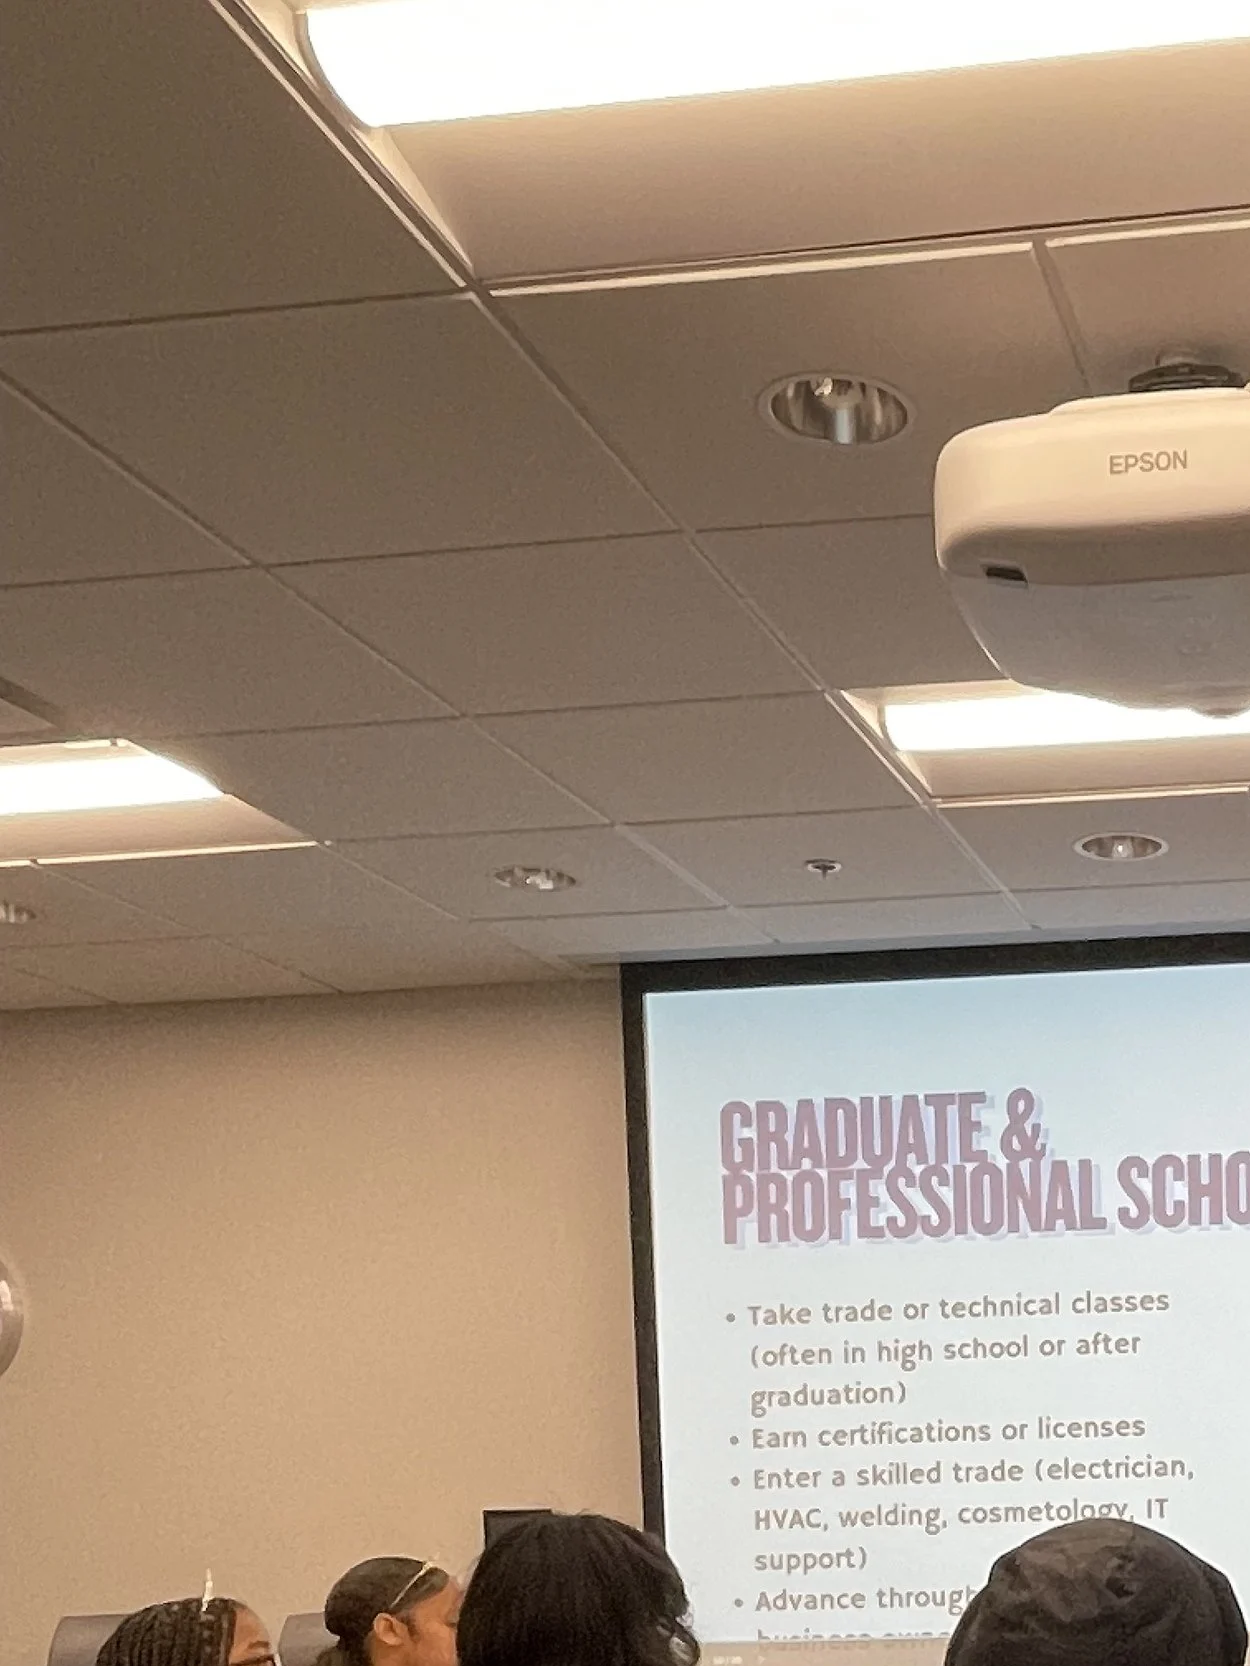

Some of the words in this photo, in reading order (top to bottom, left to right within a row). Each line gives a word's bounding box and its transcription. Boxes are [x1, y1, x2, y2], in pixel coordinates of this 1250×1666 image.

[1109, 449, 1188, 475] EPSON
[718, 1090, 988, 1172] GRADUATE
[1000, 1087, 1047, 1163] &
[721, 1157, 1109, 1244] PROFESSIONAL
[746, 1302, 813, 1327] Take
[821, 1298, 893, 1323] trade
[902, 1302, 931, 1321] or
[938, 1290, 1062, 1320] technical
[1070, 1288, 1171, 1315] classes
[749, 1340, 834, 1368] (often
[842, 1338, 867, 1364] in
[876, 1338, 934, 1372] high
[942, 1333, 1031, 1360] school
[1037, 1337, 1067, 1357] or
[1074, 1331, 1142, 1356] after
[749, 1378, 908, 1418] graduation)
[751, 1427, 808, 1450] Earn
[816, 1417, 992, 1447] certifications
[1000, 1420, 1029, 1441] or
[1036, 1415, 1147, 1440] licenses
[753, 1468, 822, 1490] Enter
[831, 1469, 846, 1488] a
[855, 1460, 943, 1487] skilled
[952, 1460, 1025, 1484] trade
[1035, 1454, 1196, 1484] (electrician,
[754, 1508, 830, 1533] HVAC,
[838, 1503, 949, 1537] welding,
[957, 1497, 1135, 1526] cosmetology,
[1146, 1497, 1170, 1520] IT
[754, 1546, 869, 1575] support)
[755, 1588, 867, 1612] Advance
